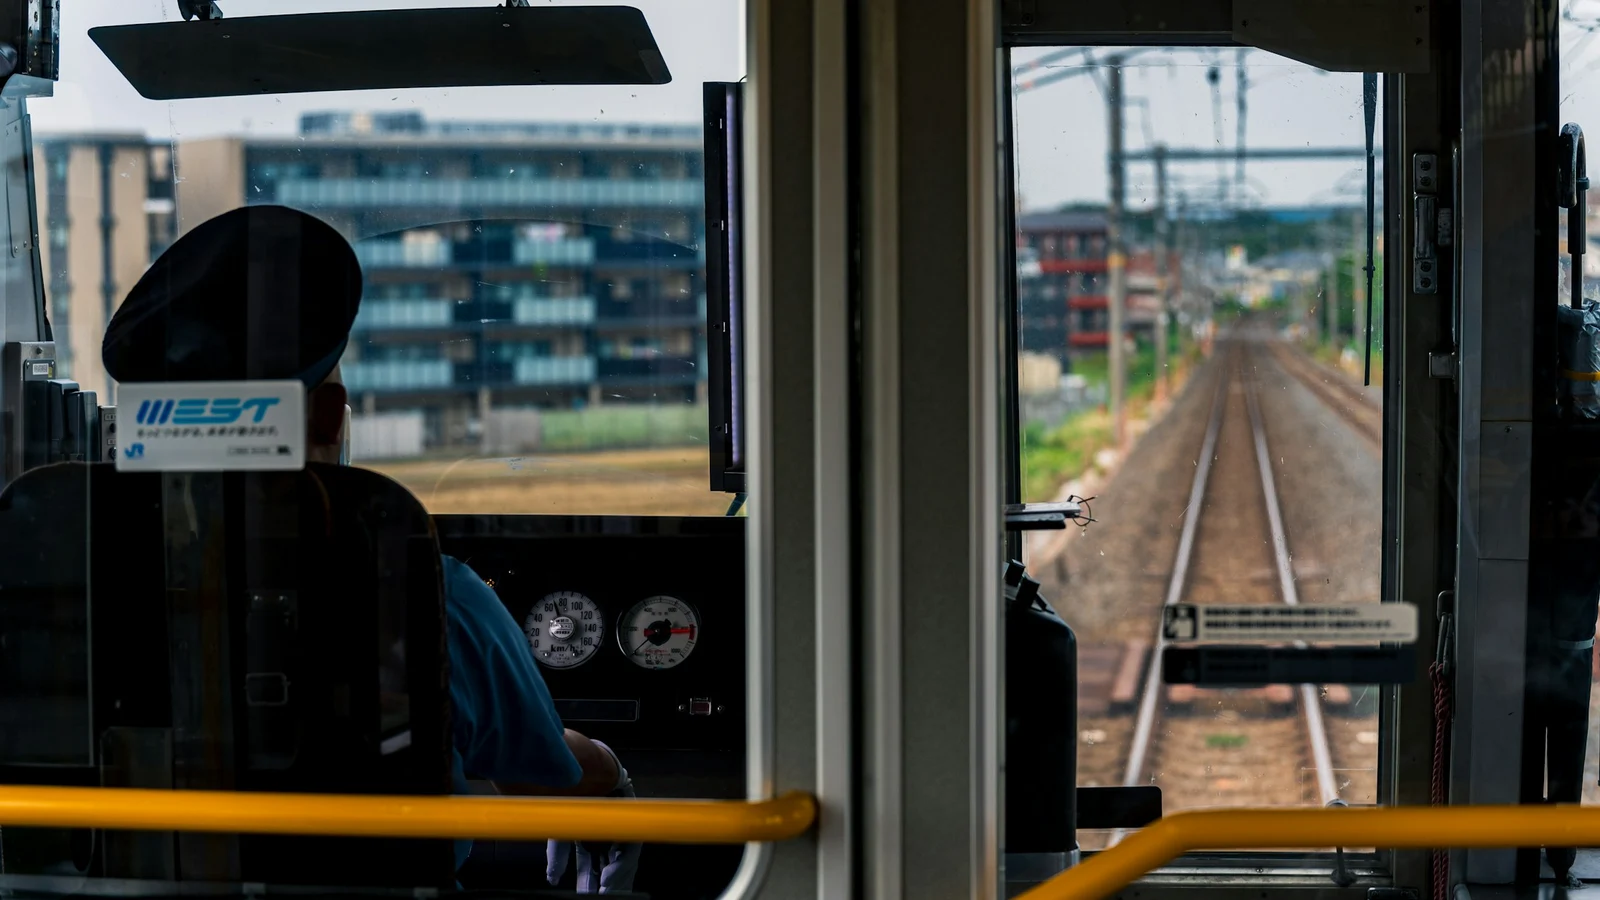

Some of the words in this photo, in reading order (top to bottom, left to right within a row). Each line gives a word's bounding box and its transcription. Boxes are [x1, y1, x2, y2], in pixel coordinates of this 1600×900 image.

[124, 442, 145, 459] JR
[558, 597, 568, 607] 80
[570, 601, 583, 611] 100
[544, 603, 554, 612] 60
[533, 613, 543, 623] 40
[580, 610, 593, 620] 120
[530, 627, 540, 637] 20
[584, 623, 597, 633] 140
[534, 639, 540, 649] 0
[580, 636, 593, 646] 160
[550, 643, 575, 653] km/h
